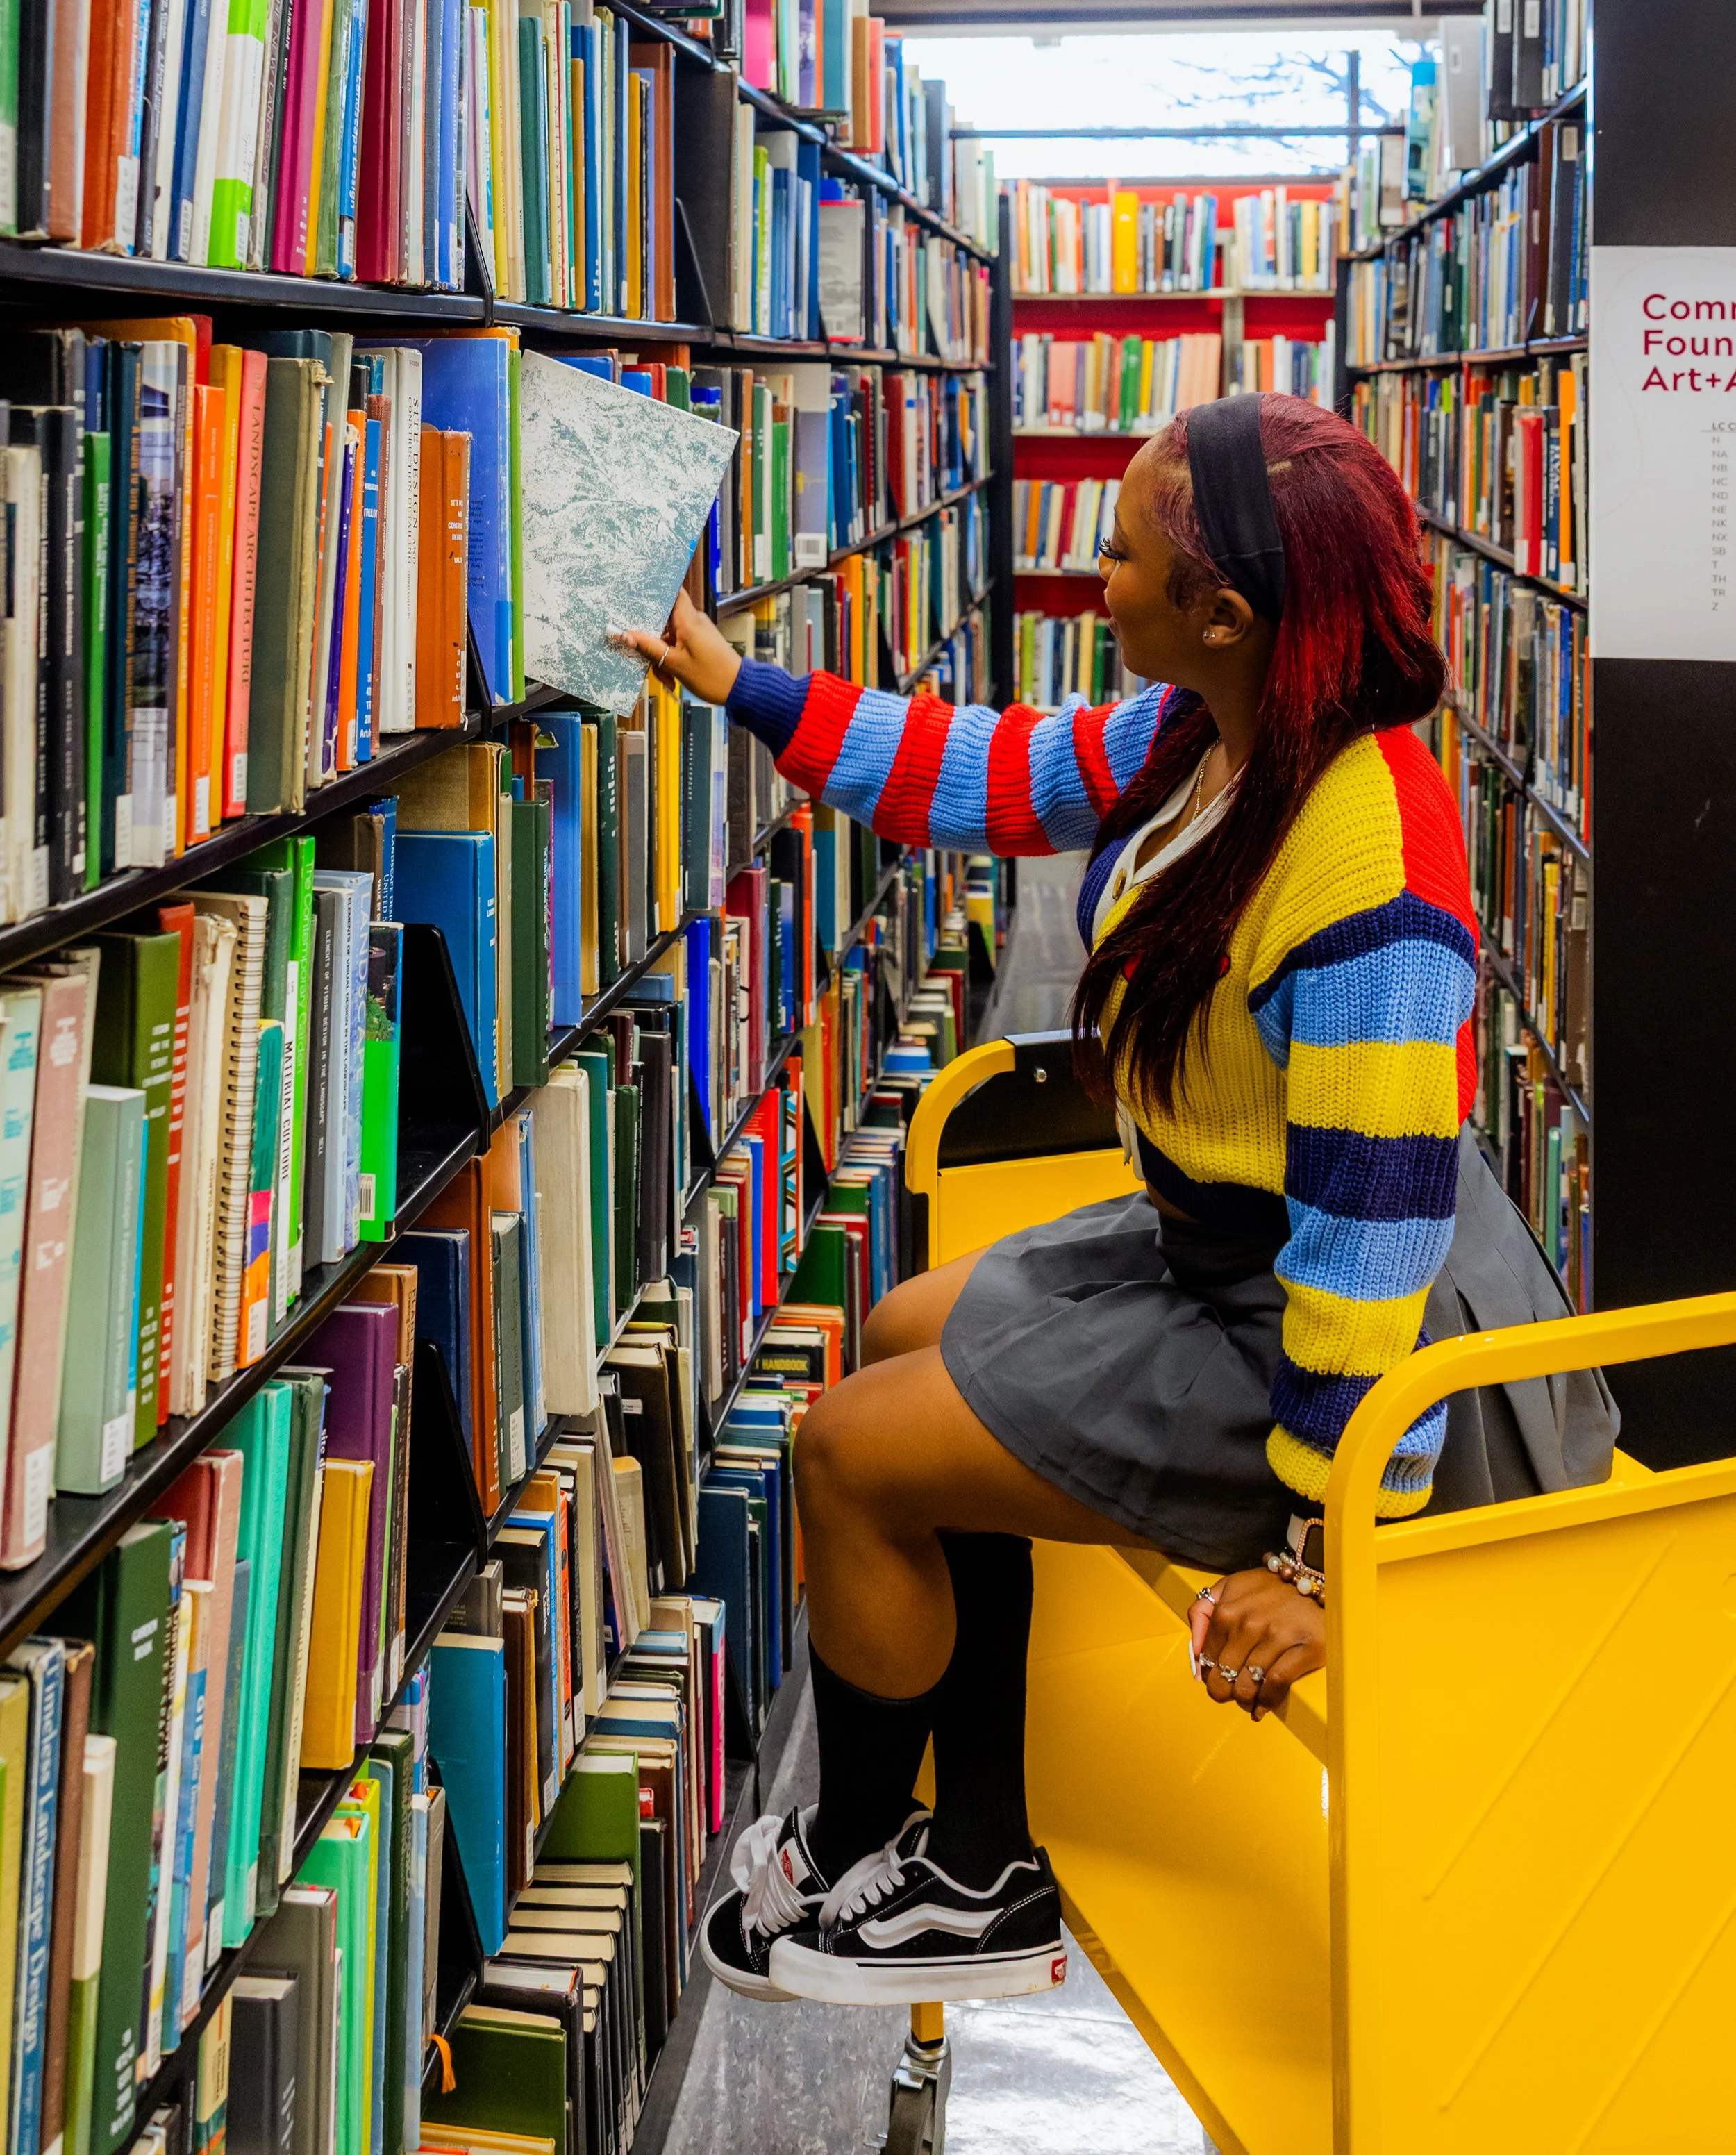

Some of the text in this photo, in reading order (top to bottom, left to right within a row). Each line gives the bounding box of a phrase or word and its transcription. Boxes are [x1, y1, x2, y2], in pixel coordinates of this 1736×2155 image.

[285, 7, 293, 50] LANDSCAPE
[451, 49, 460, 91] Design
[261, 31, 279, 182] NEW LANDSCAP
[452, 95, 458, 110] on
[349, 75, 362, 208] Landscape Design
[1642, 294, 1736, 320] Com
[1644, 330, 1733, 356] Foun
[1712, 422, 1726, 431] LC
[1712, 436, 1720, 444] N
[1712, 450, 1728, 458] NA
[385, 463, 390, 472] IN
[1712, 463, 1728, 472] NB
[1712, 477, 1728, 486] NC
[1712, 491, 1728, 500] ND
[1712, 505, 1727, 514] NE
[1712, 519, 1727, 528] NK
[1712, 533, 1728, 541] NX
[241, 406, 261, 690] LANDSCAPE ARCHITECTURE
[1712, 547, 1726, 556] SB
[1712, 560, 1719, 569] T
[1712, 574, 1726, 583] TH
[1712, 588, 1726, 597] TR
[1712, 602, 1719, 611] Z
[376, 901, 381, 911] BY
[346, 945, 351, 956] OF
[297, 859, 313, 1074] The Contemporary Garden
[324, 970, 330, 981] OF
[355, 890, 370, 1085] LANDSCAPE
[344, 1029, 349, 1038] IN
[322, 1050, 326, 1059] IN
[281, 1041, 293, 1183] MATERIAL CULTURE
[320, 1428, 328, 1454] site
[194, 1695, 205, 1742] GIS
[40, 1662, 60, 1786] Timeless
[28, 1789, 54, 1941] Landscape
[23, 1945, 47, 2056] Design
